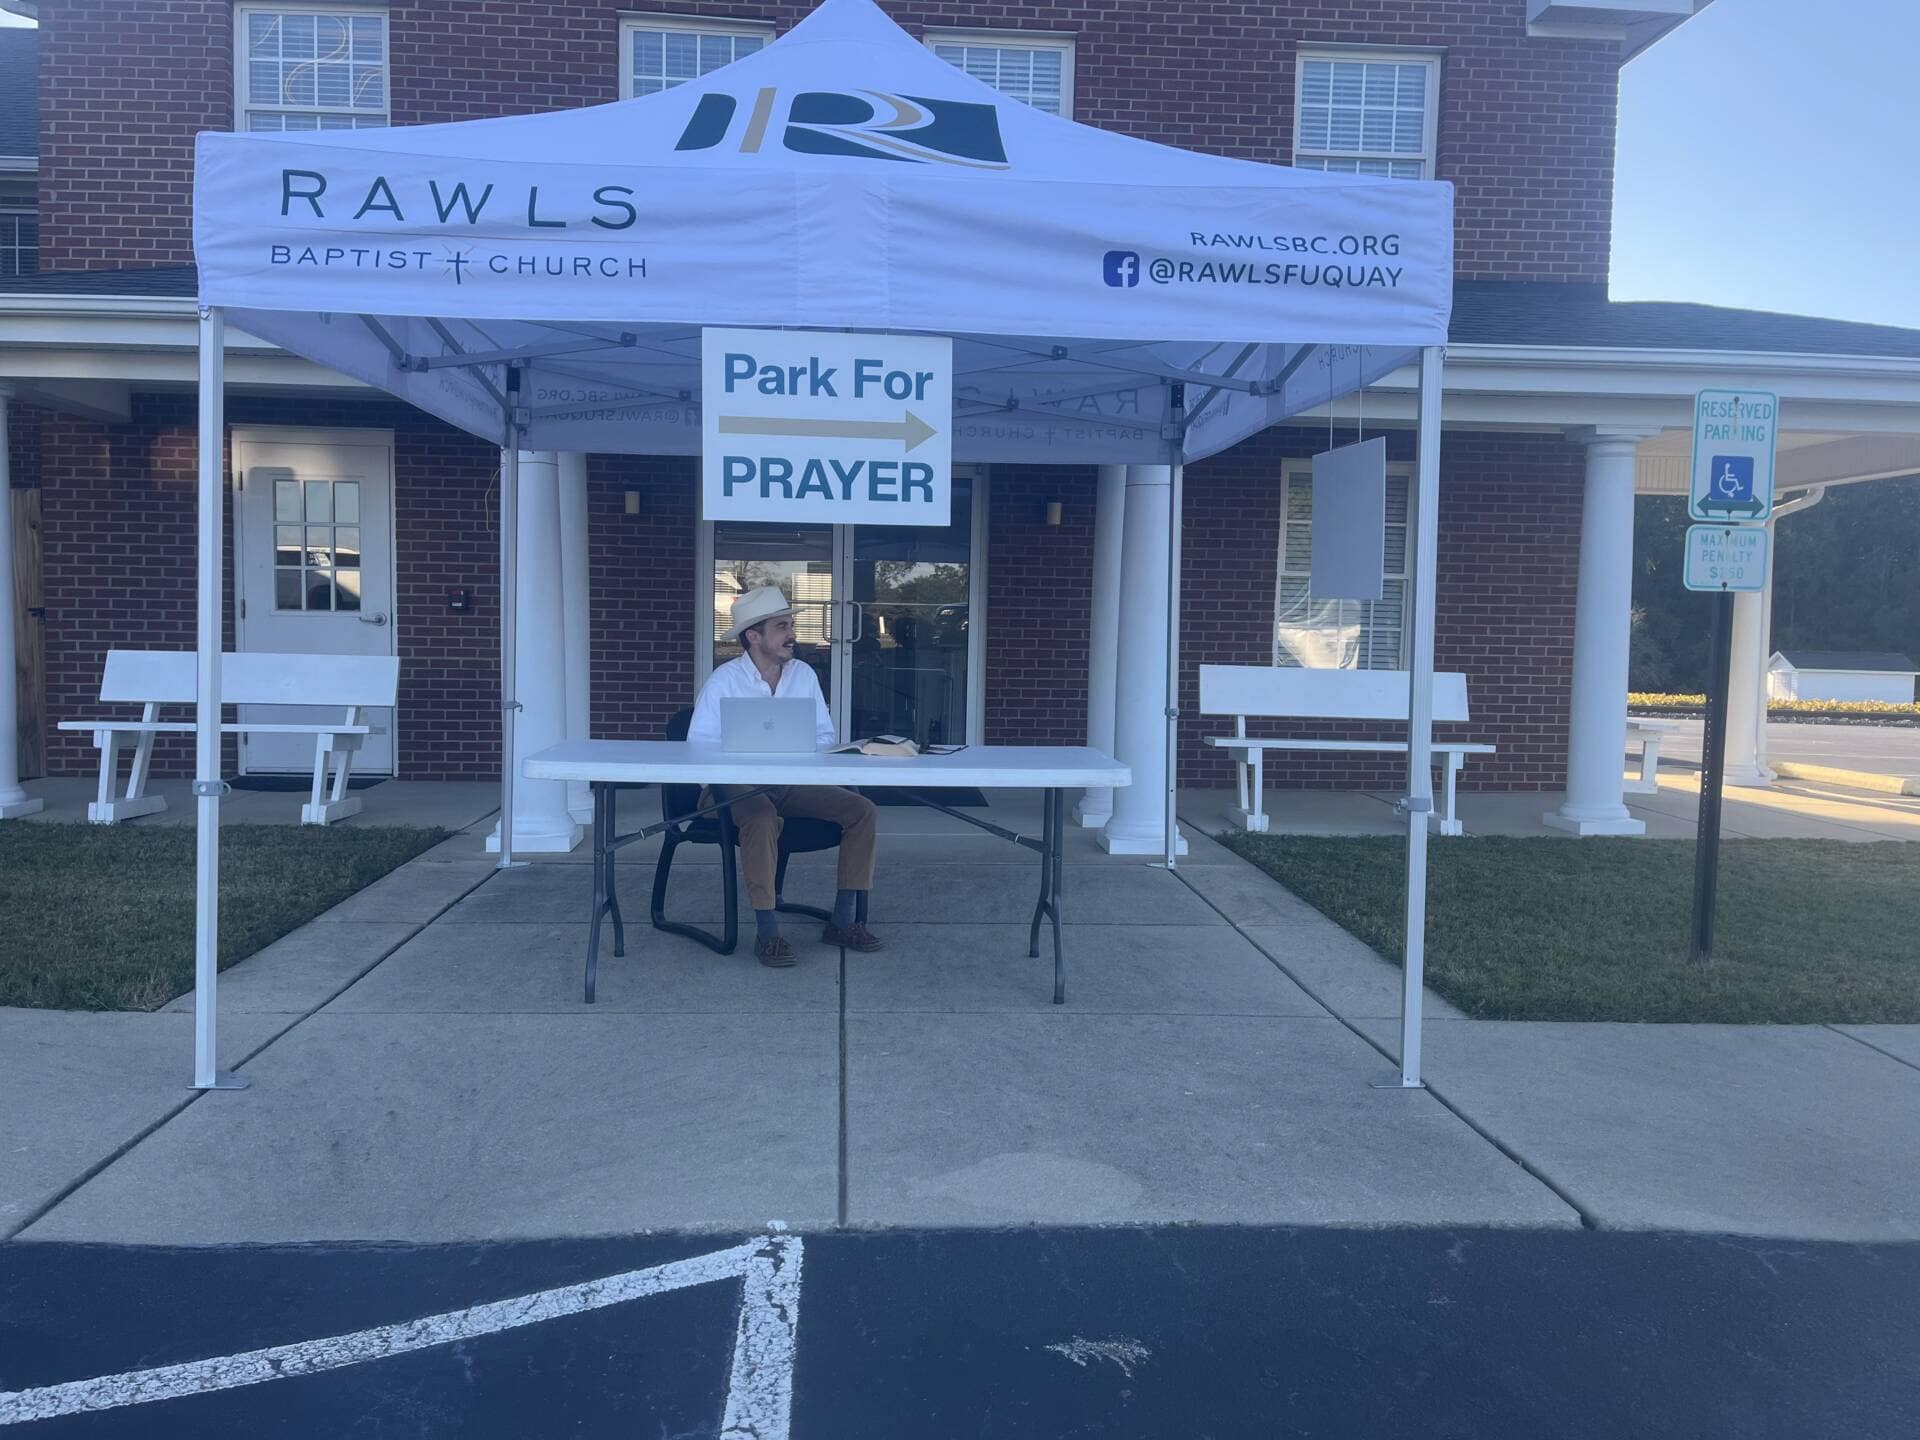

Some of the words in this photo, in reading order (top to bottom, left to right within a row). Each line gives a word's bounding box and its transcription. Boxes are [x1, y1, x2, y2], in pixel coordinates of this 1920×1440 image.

[280, 169, 637, 230] RAWLS
[1191, 232, 1400, 256] RAWLSBC.ORG
[270, 244, 433, 270] BAPTIST
[488, 254, 647, 278] CHURCH
[1149, 257, 1403, 288] @RAWLSFUQUAY
[724, 352, 838, 398] Park
[853, 358, 934, 401] For
[1701, 400, 1772, 420] RESERVED
[1704, 424, 1766, 442] PARING
[722, 455, 935, 503] PRAYER
[1702, 549, 1753, 563] PENLTY
[1709, 566, 1745, 580] $50
